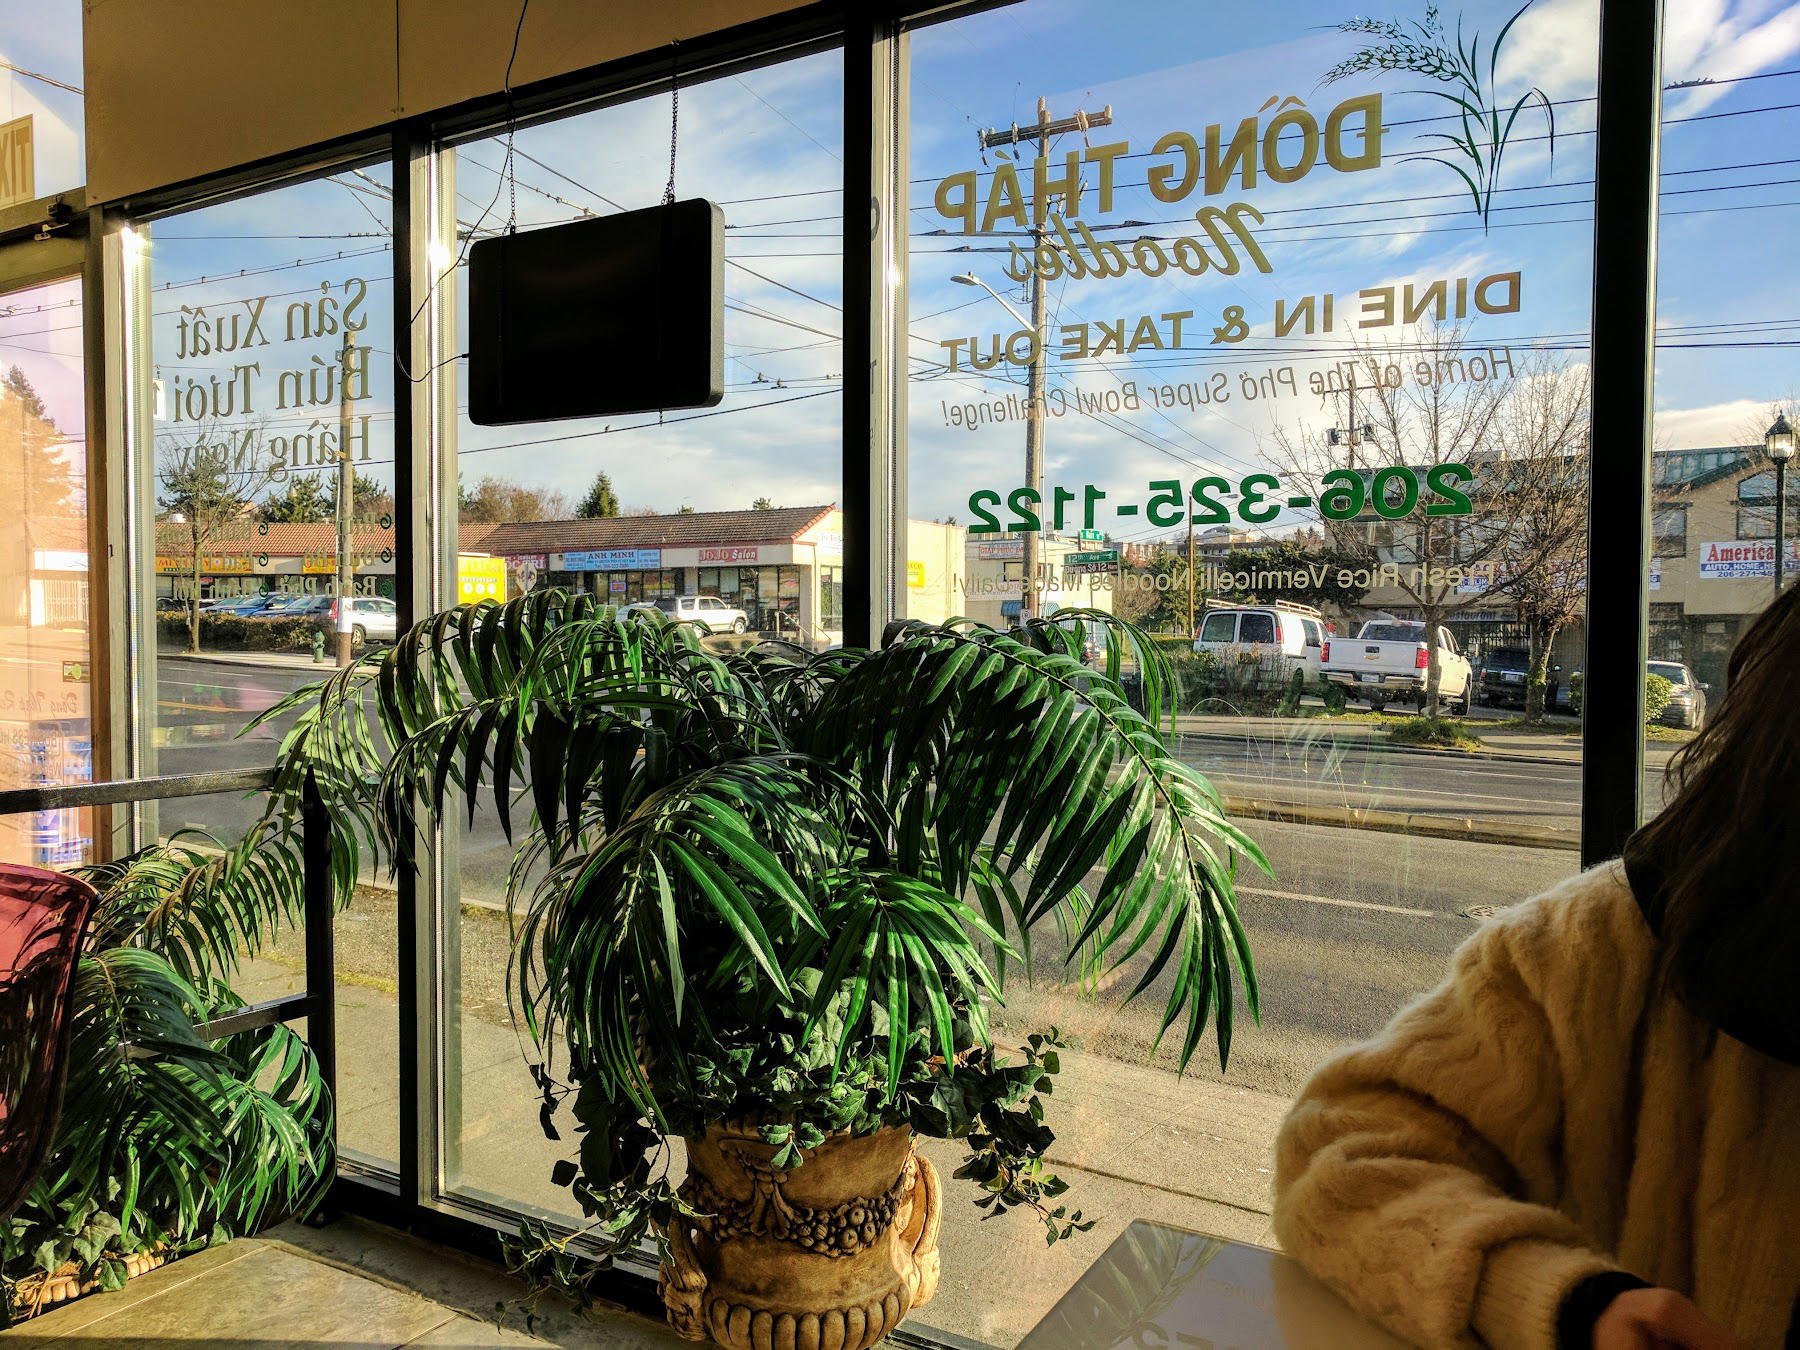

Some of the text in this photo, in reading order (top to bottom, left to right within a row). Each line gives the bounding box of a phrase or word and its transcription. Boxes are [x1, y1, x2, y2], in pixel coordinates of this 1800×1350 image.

[0, 124, 30, 198] XIT
[610, 551, 635, 559] MINH
[731, 549, 757, 560] Salon
